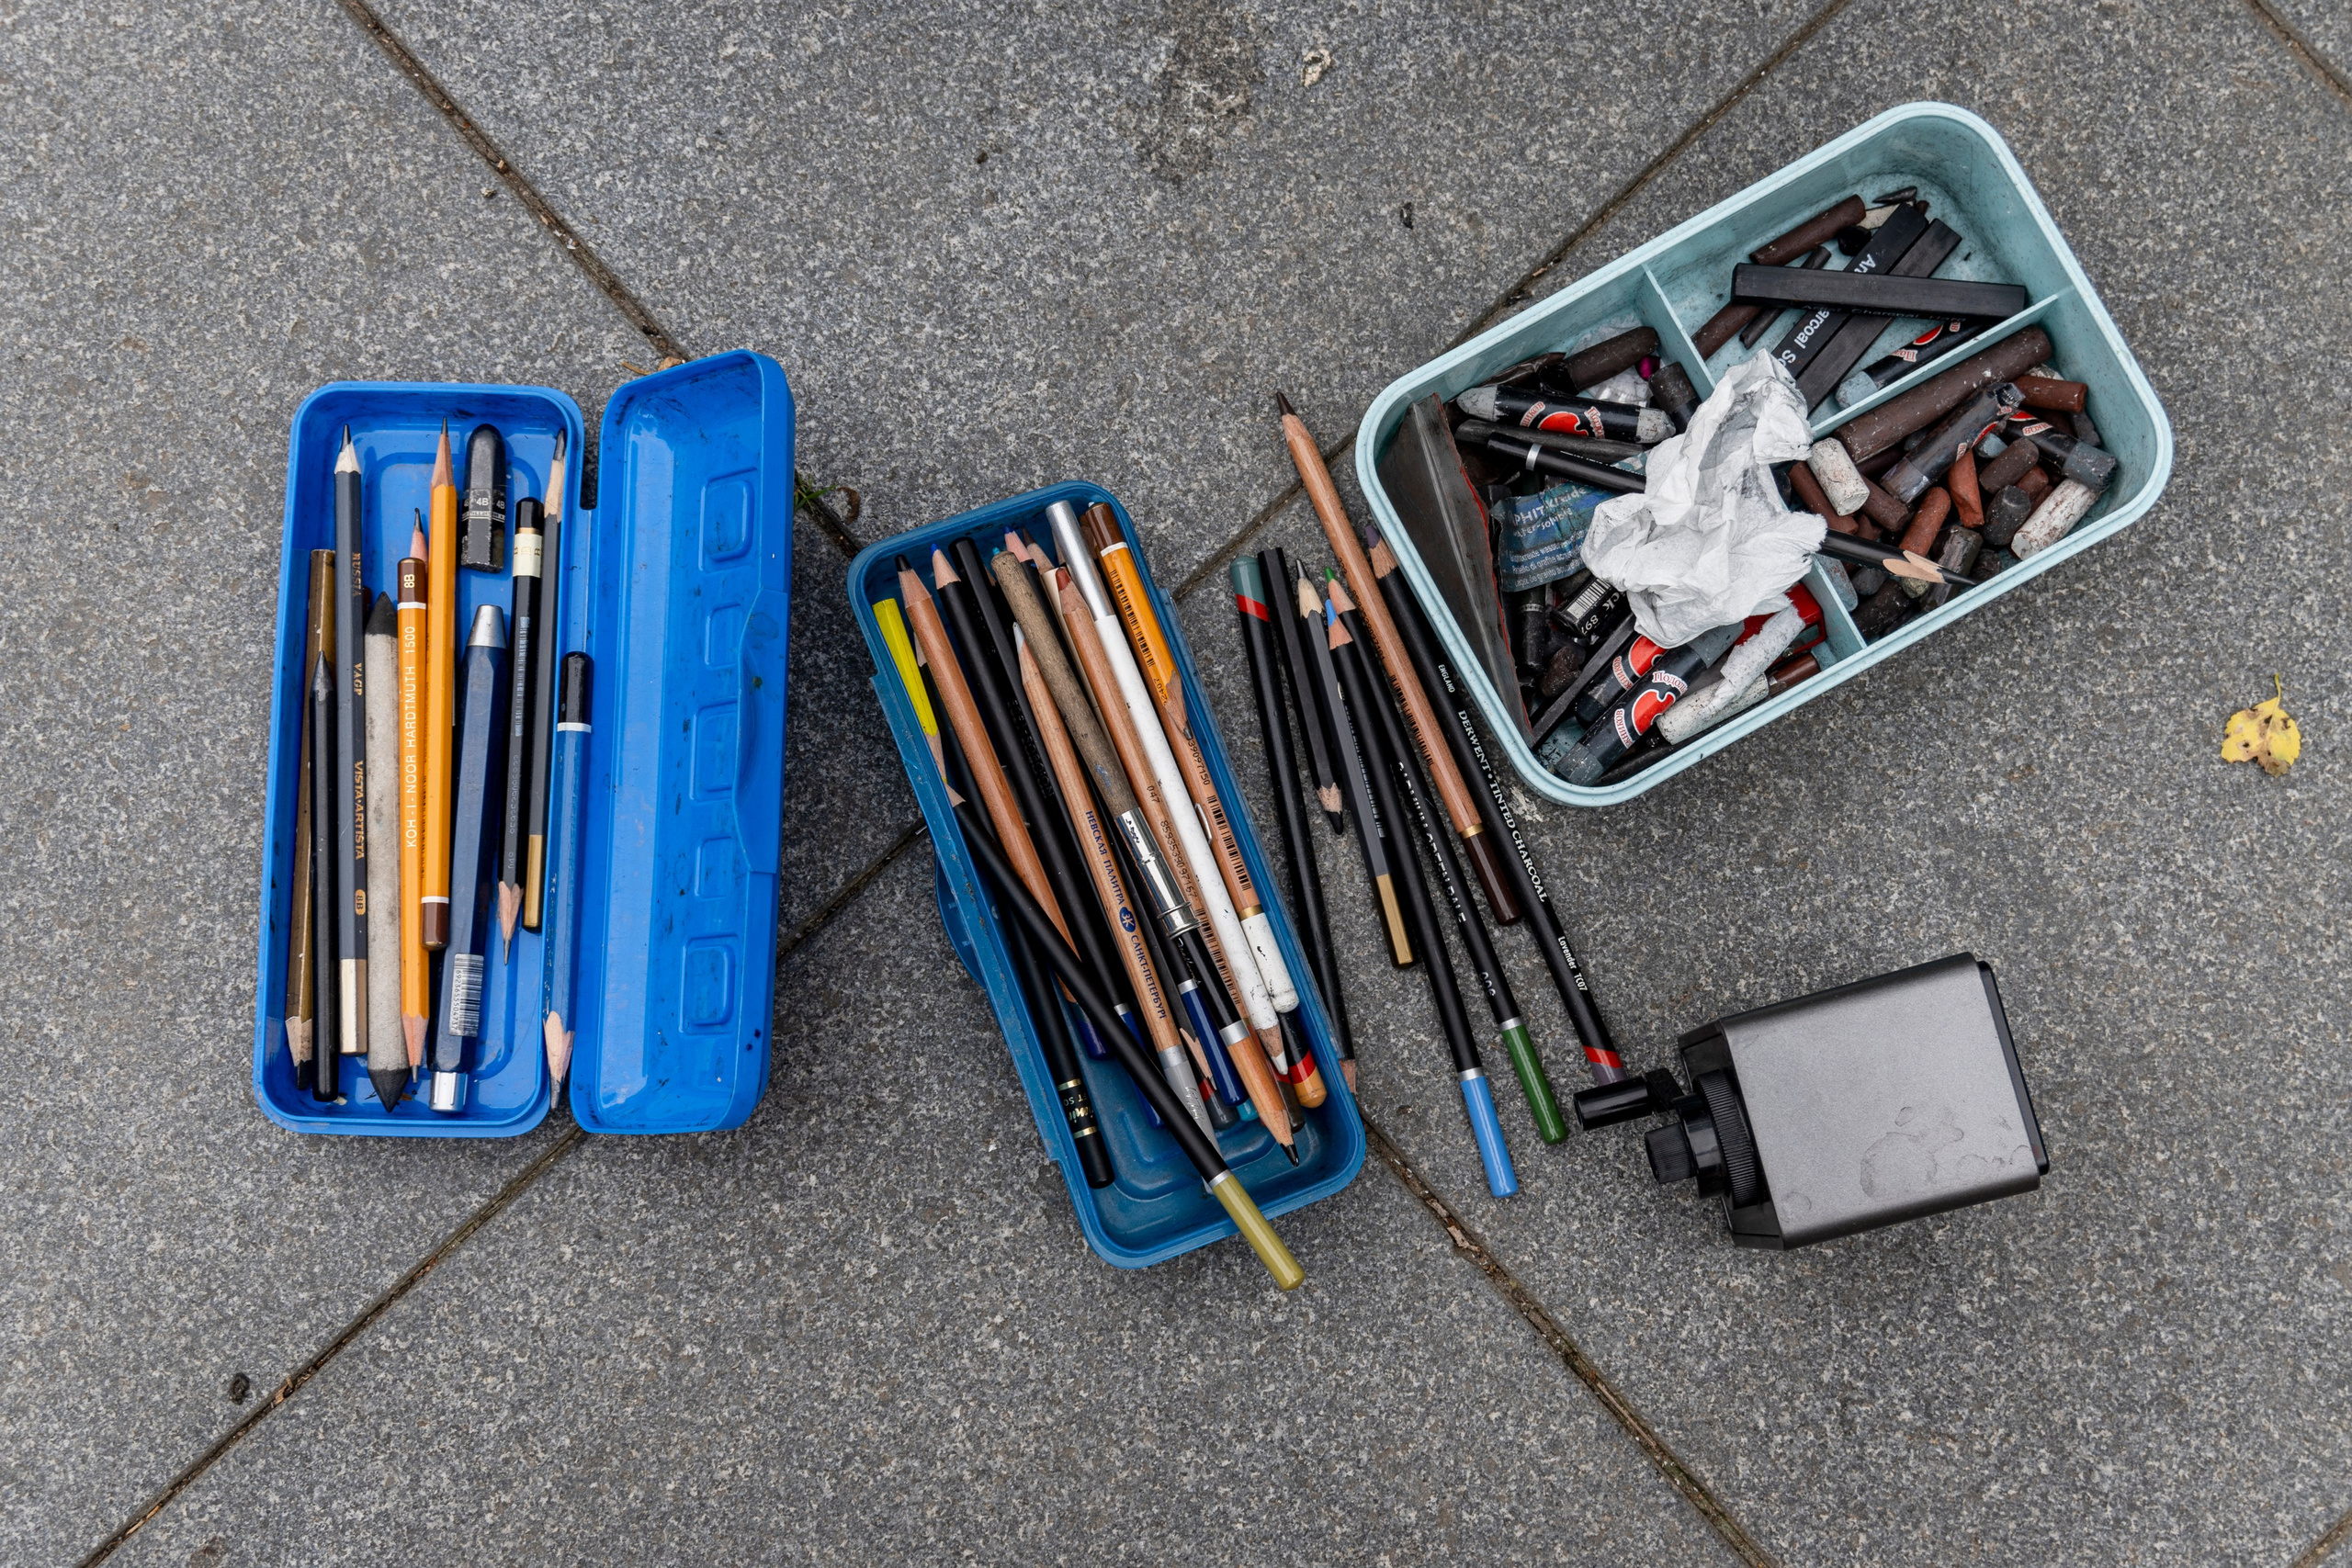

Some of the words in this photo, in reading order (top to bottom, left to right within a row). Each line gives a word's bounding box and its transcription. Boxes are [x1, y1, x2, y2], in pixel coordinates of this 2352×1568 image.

[1793, 309, 1829, 349] arcoal
[476, 497, 489, 506] 4B
[352, 552, 362, 597] RUSSIA
[404, 573, 415, 589] 8B
[1602, 592, 1620, 612] ck
[404, 626, 415, 654] 1500
[1153, 678, 1170, 705] 2407
[1438, 664, 1455, 694] ENGLAND
[1614, 656, 1633, 690] жников
[405, 666, 416, 749] HARDTMUTH
[1615, 709, 1634, 748] жников
[1186, 738, 1211, 786] 39097150
[1147, 785, 1160, 805] 047
[1458, 710, 1491, 776] DERWENT
[1489, 780, 1516, 829] TINTED
[1511, 829, 1545, 903] CHARCOAL
[1085, 810, 1108, 856] НЕВСКАЯ
[1102, 859, 1126, 906] ПАЛИТРА
[1159, 819, 1198, 898] 8593539097167
[356, 894, 364, 911] 8B
[1130, 934, 1168, 1021] САНКТ-ПЕТЕРБУРГ
[1557, 935, 1577, 970] Lavender
[1573, 972, 1589, 991] TC07
[451, 969, 462, 1031] 6923655504737
